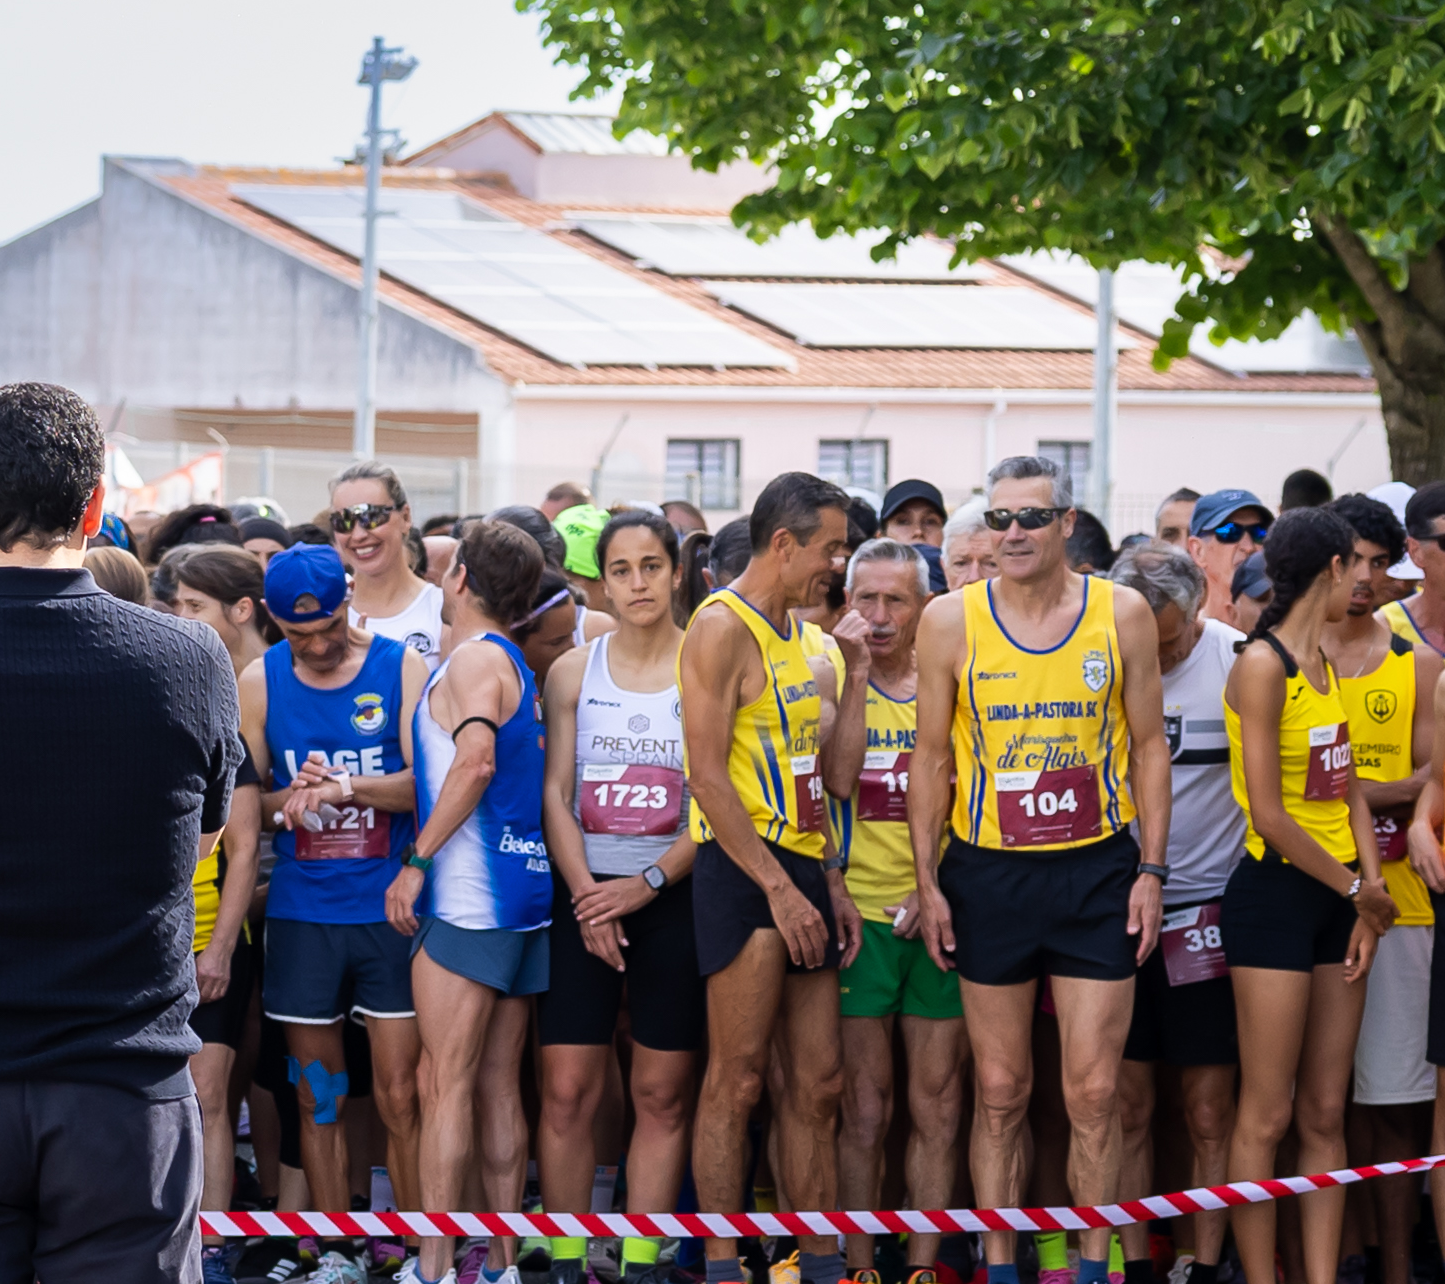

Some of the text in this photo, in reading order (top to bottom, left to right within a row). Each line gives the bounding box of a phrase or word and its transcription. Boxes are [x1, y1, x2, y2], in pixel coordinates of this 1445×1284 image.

[986, 701, 1084, 722] LINDA-A-PASTORA
[592, 735, 680, 754] PREVENT
[609, 750, 684, 766] SPRAIN
[593, 784, 668, 809] 1723
[1018, 788, 1079, 817] 104
